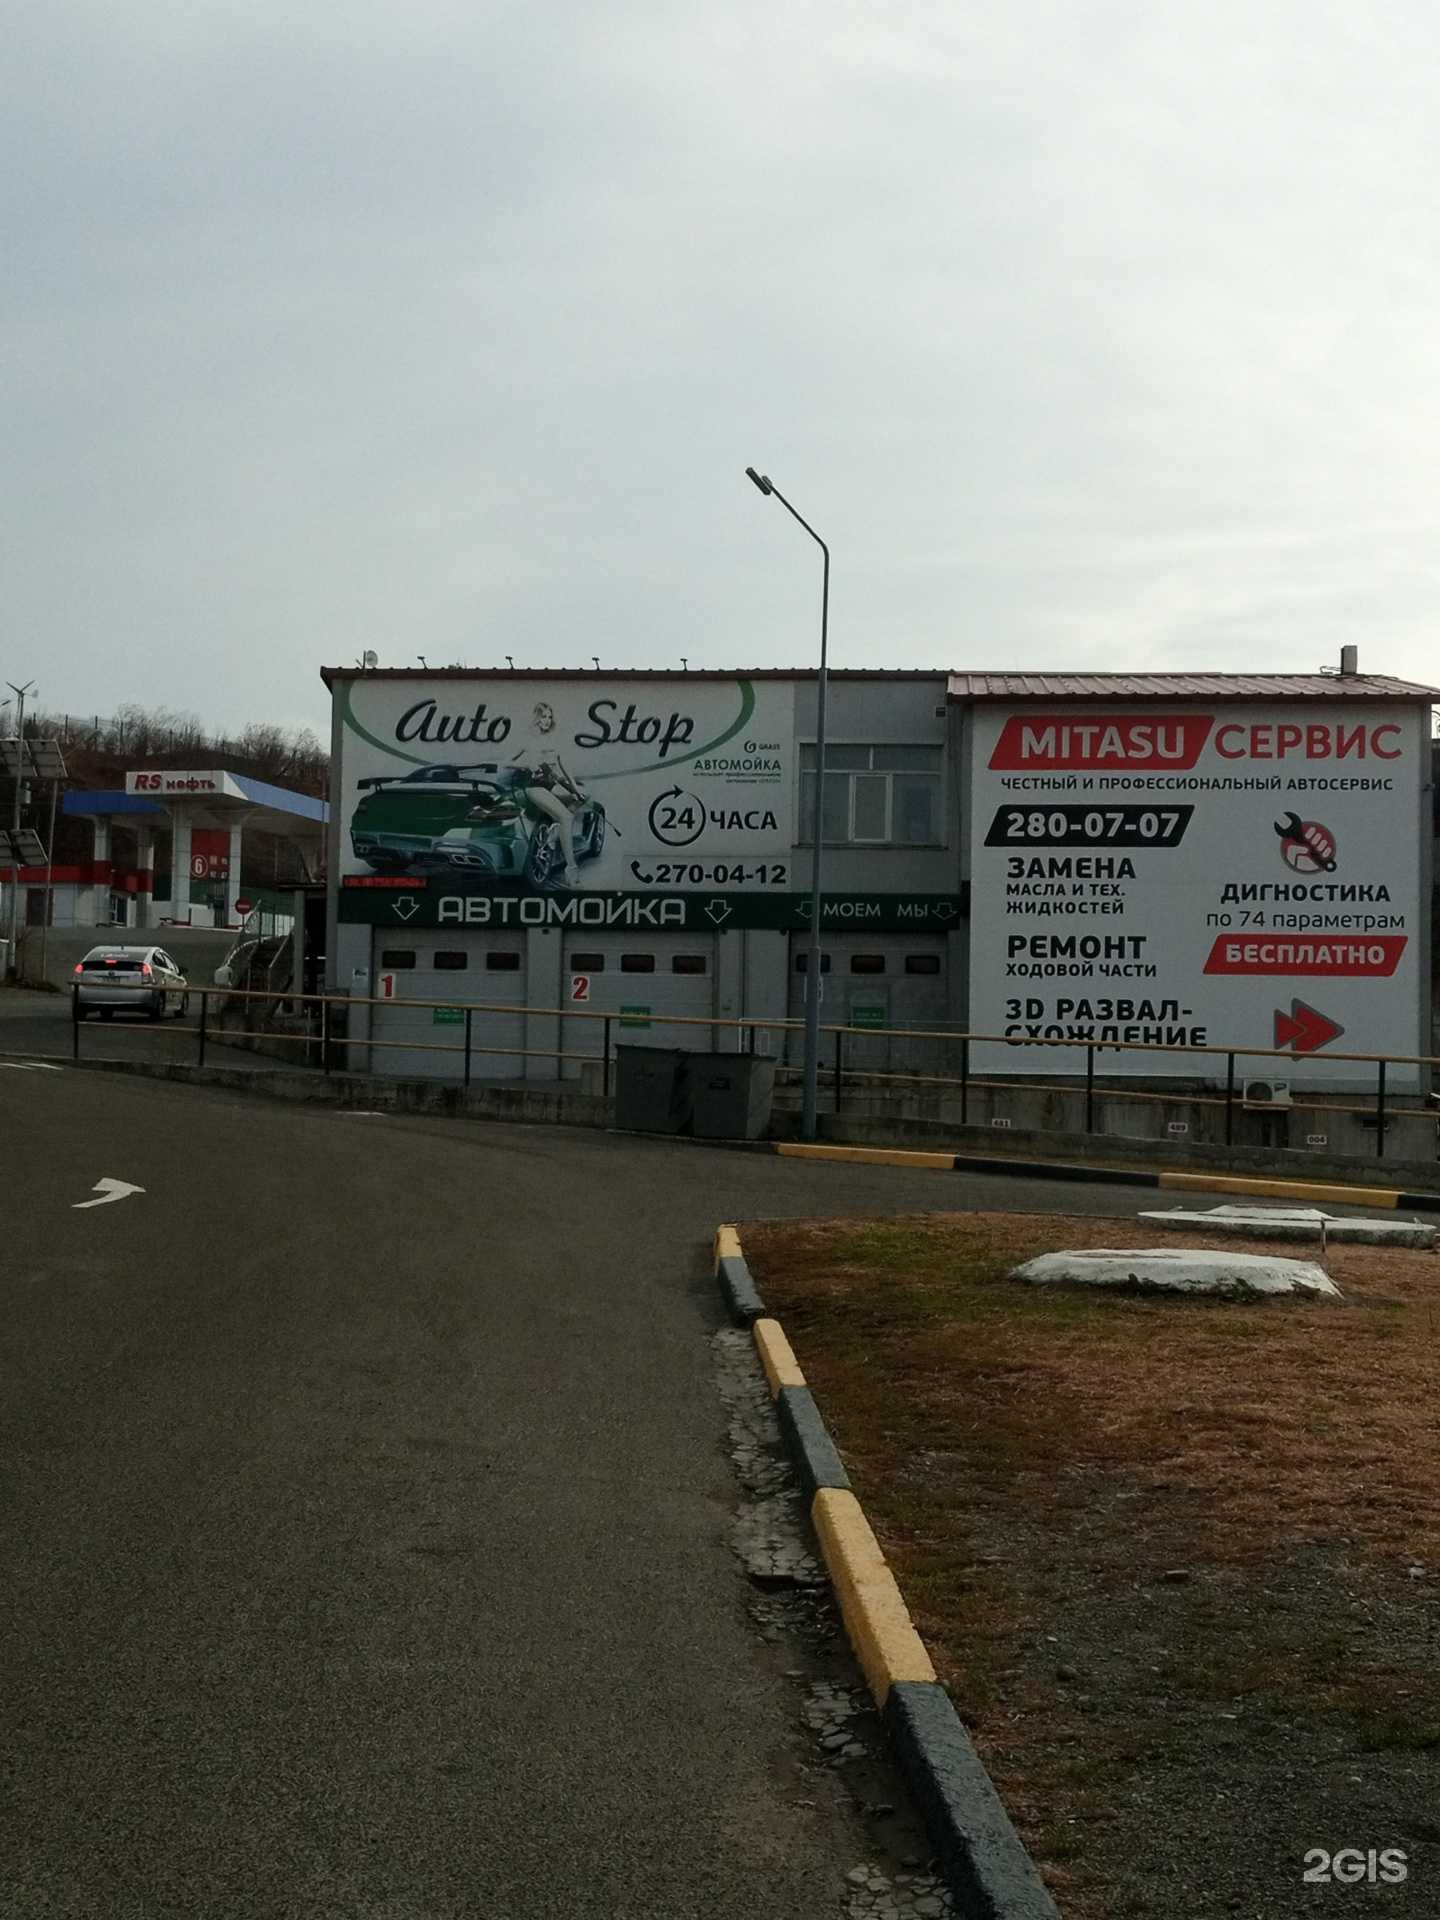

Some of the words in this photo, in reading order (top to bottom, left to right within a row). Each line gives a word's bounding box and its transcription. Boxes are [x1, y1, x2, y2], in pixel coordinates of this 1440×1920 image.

[396, 699, 511, 743] Auto
[574, 699, 695, 757] Stop
[1020, 726, 1185, 759] MITASU
[1214, 724, 1403, 760] СЕРВИС
[694, 757, 781, 771] АВТОМОЙКА
[135, 774, 162, 790] RS
[1001, 775, 1077, 790] ЧЕСТНЫЙ
[1082, 777, 1094, 790] И
[1099, 775, 1282, 791] ПРОФЕССИОНАЛЬНЫЙ
[1286, 778, 1393, 791] АВТОСЕРВИС
[661, 807, 696, 830] 24
[710, 810, 778, 830] ЧАСА
[1006, 812, 1180, 838] 280-07-07
[656, 864, 787, 885] 270-04-12
[1007, 857, 1136, 880] ЗАМЕНА
[1006, 883, 1067, 897] МАСЛА
[1071, 884, 1084, 897] И
[1089, 884, 1126, 897] ТЕХ.
[1220, 883, 1391, 905] ДИГНОСТИКА
[823, 902, 881, 918] МОЕМ
[896, 903, 928, 918] МЫ
[1006, 900, 1124, 917] ЖИДКОСТЕЙ
[1206, 913, 1232, 928] по
[1239, 910, 1266, 928] 74
[1272, 913, 1405, 933] параметрам
[1007, 935, 1147, 960] РЕМОНТ
[1225, 943, 1385, 965] БЕСПЛАТНО
[1006, 962, 1094, 979] ХОДОВОЙ
[1098, 963, 1157, 978] ЧАСТИ
[381, 975, 393, 998] 1
[573, 977, 589, 1000] 2
[1005, 998, 1045, 1021] 3D
[1056, 998, 1193, 1022] РАЗВАЛ-
